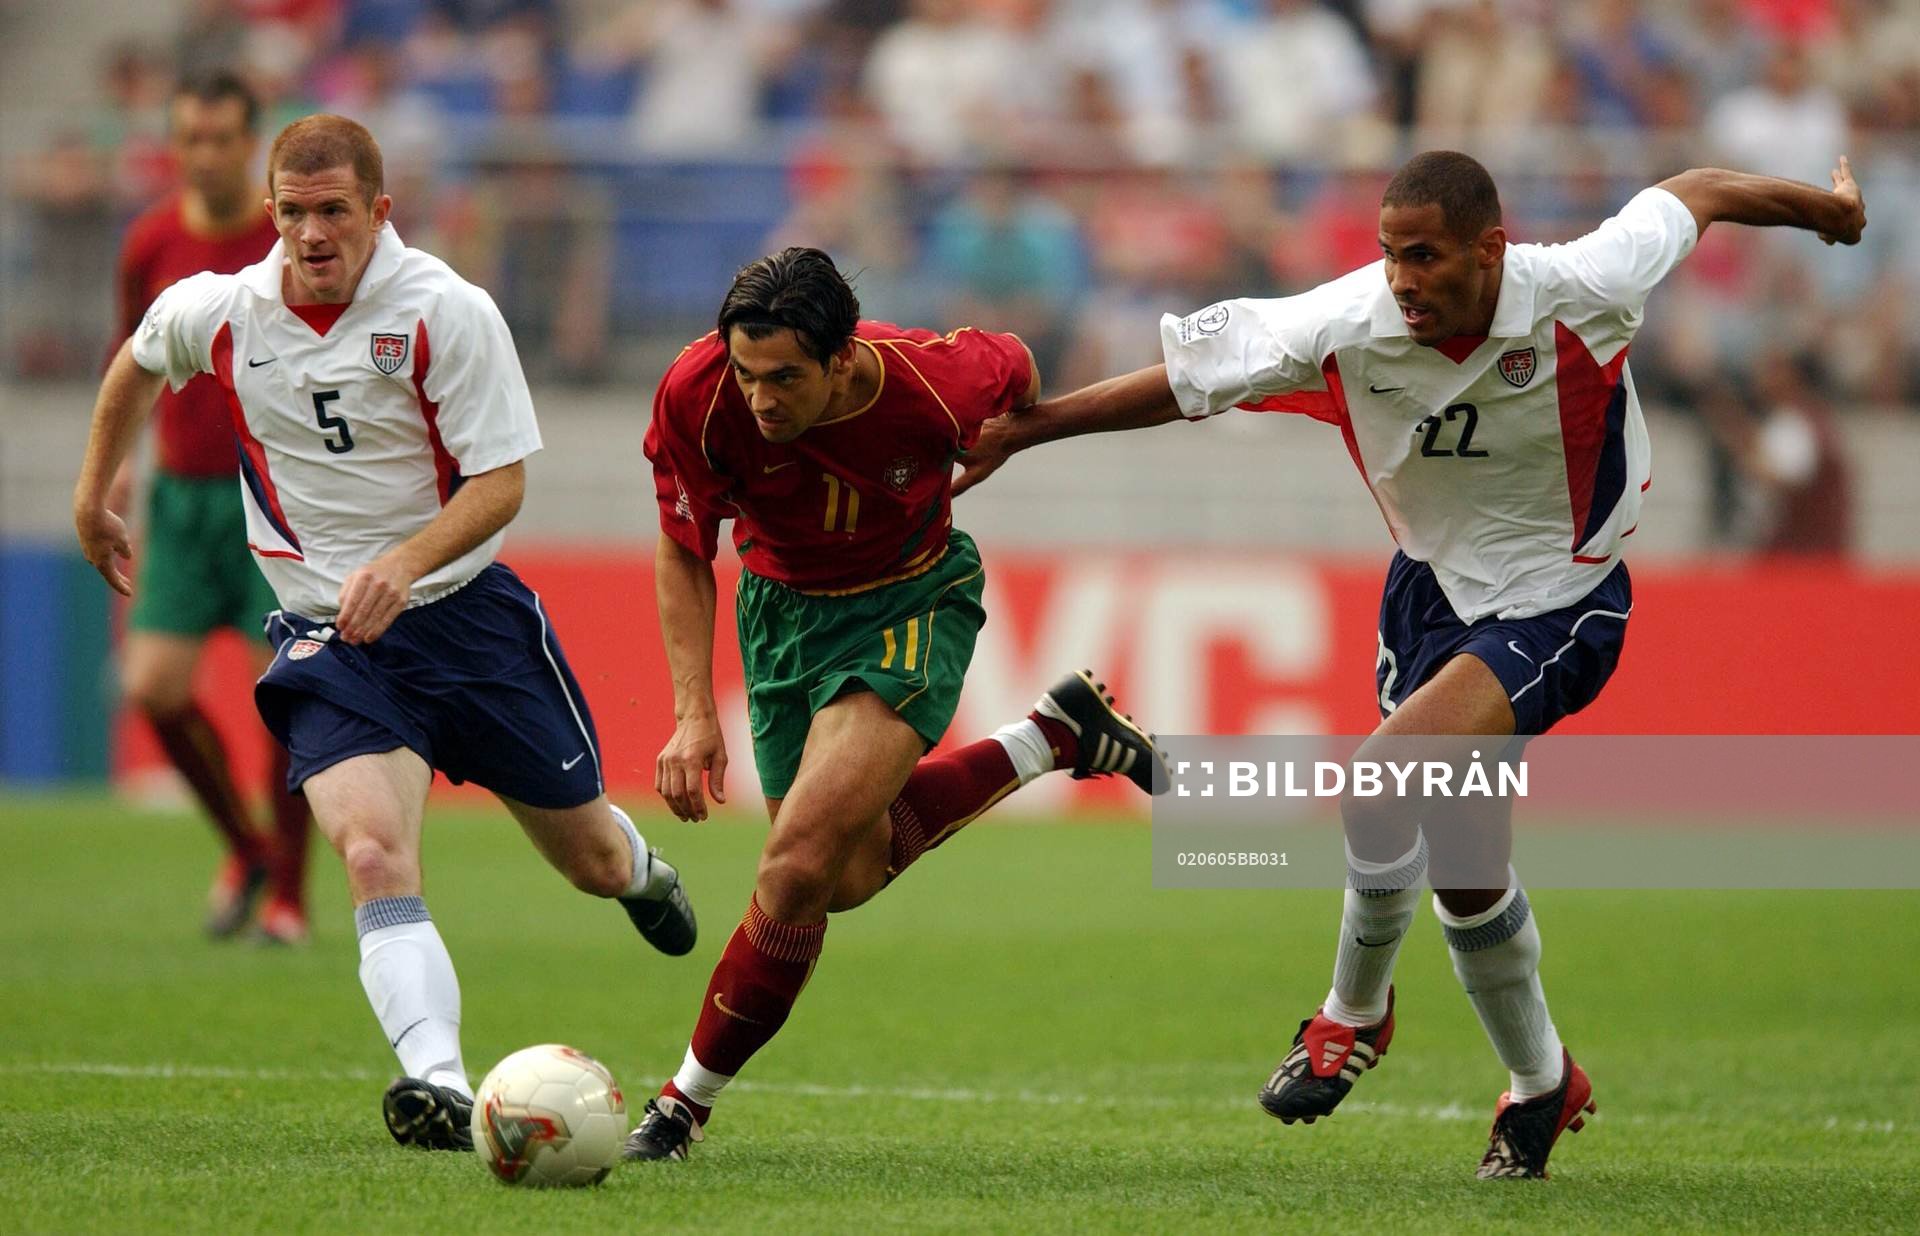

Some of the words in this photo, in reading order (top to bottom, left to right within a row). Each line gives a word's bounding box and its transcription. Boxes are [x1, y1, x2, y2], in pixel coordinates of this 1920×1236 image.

[312, 390, 354, 454] 5
[1416, 402, 1490, 458] 22
[822, 472, 860, 534] 11
[880, 616, 919, 671] 11
